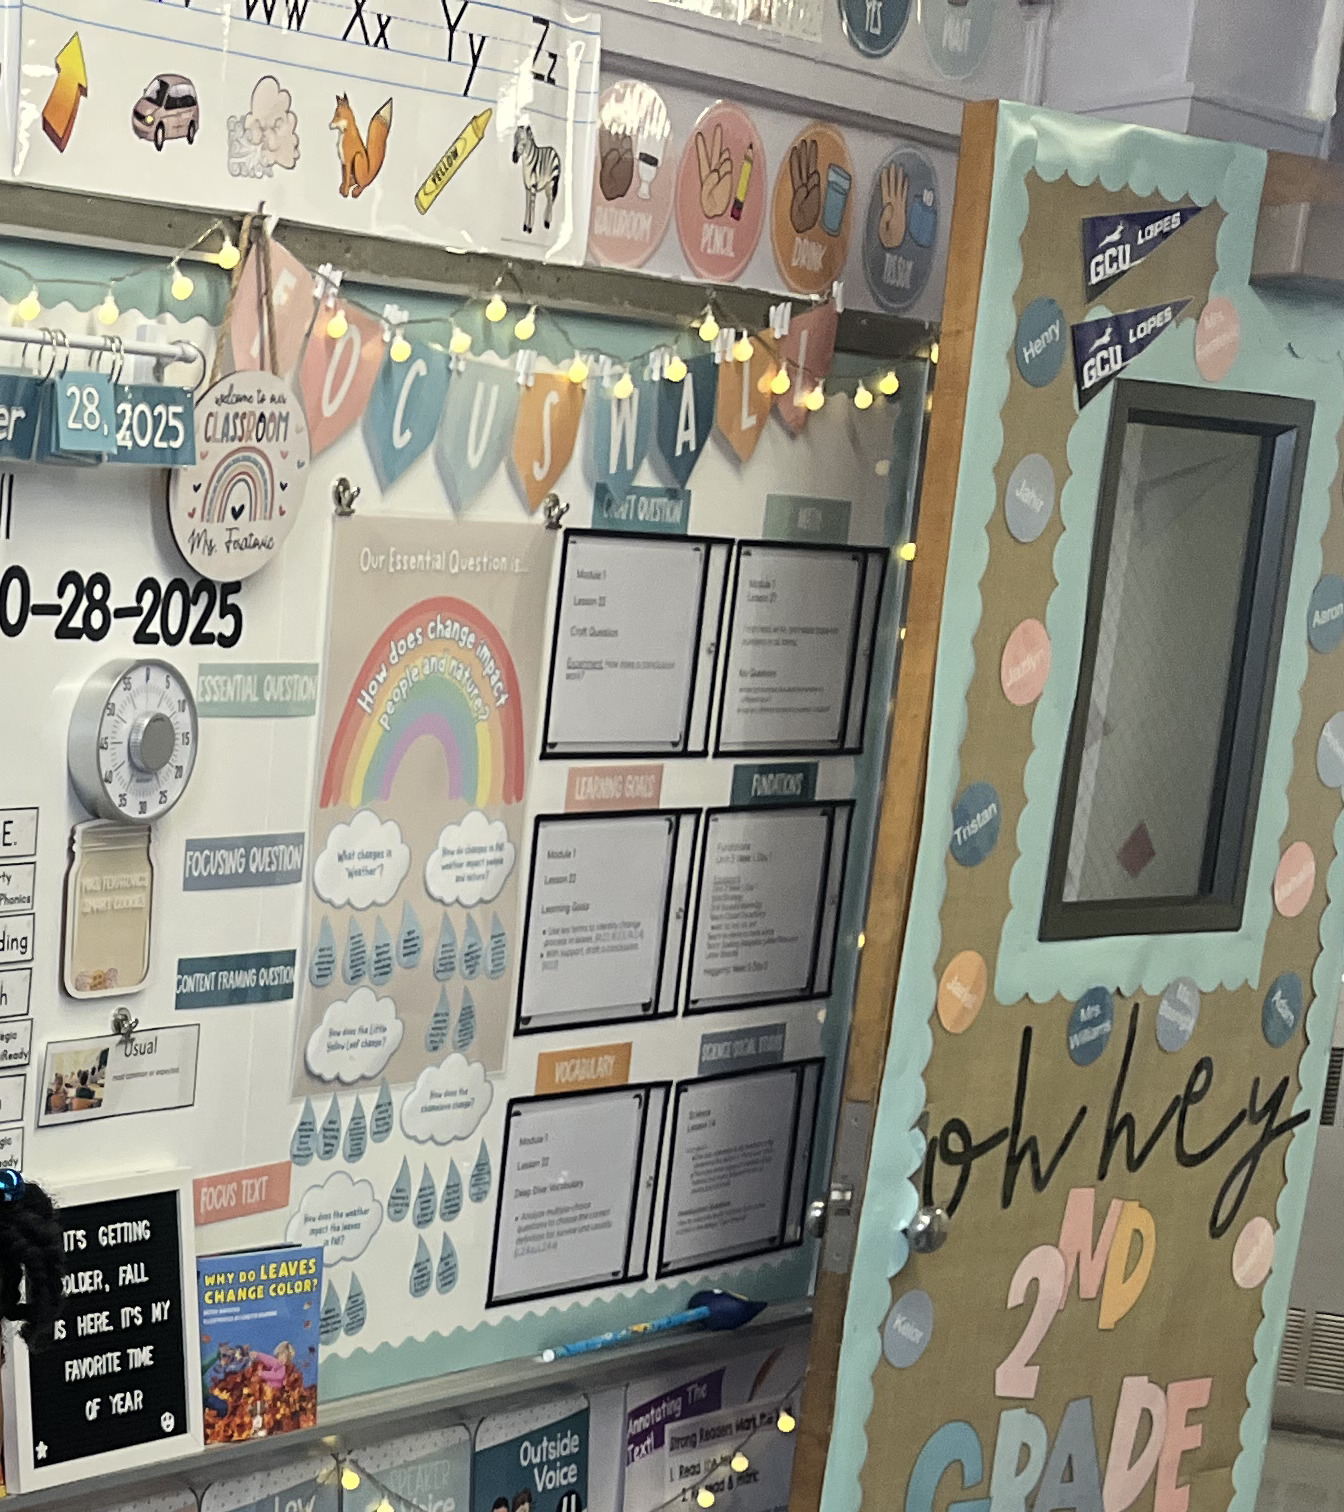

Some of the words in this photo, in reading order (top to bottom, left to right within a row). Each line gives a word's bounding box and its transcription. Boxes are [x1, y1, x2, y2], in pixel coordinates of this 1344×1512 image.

[701, 224, 735, 257] PENCIL
[1136, 212, 1181, 246] LOPES
[1088, 244, 1131, 285] GCU
[1023, 319, 1061, 364] Henry
[1128, 307, 1173, 344] LOPES
[1081, 345, 1123, 390] GCU
[66, 385, 108, 436] 28,
[115, 402, 185, 449] 2025
[204, 411, 290, 443] CLASSROOM
[357, 664, 387, 715] How
[388, 627, 423, 665] does
[427, 614, 476, 649] change
[475, 640, 509, 707] impact
[379, 665, 420, 731] people
[424, 656, 445, 674] and
[449, 656, 490, 721] nature?
[953, 802, 1000, 844] Tristan
[185, 850, 246, 878] FOCUSING
[249, 844, 302, 873] QUESTION
[176, 969, 215, 993] CONTENT
[217, 967, 256, 990] FRAMING
[259, 963, 296, 986] QUESTION
[123, 1040, 158, 1058] Usual
[554, 1055, 616, 1083] VOCABULARY
[1098, 1001, 1311, 1238] hey
[200, 1184, 235, 1214] FOCUS
[238, 1177, 267, 1209] TEXT
[63, 1229, 87, 1252] IT'S
[98, 1220, 151, 1247] GETTING
[119, 1262, 149, 1287] FALL
[205, 1273, 234, 1286] WHY
[239, 1270, 256, 1283] DO
[260, 1258, 317, 1280] LEAVES
[204, 1285, 264, 1304] CHANGE
[269, 1278, 318, 1297] COLOR?
[54, 1320, 66, 1340] IS
[77, 1311, 114, 1337] HERE.
[121, 1305, 143, 1329] IT'S
[151, 1300, 170, 1323] MY
[65, 1352, 121, 1382] FAVORITE
[127, 1345, 154, 1370] TIME
[85, 1398, 101, 1421] OF
[109, 1389, 143, 1415] YEAR
[518, 1437, 580, 1468] Outside
[533, 1463, 578, 1492] Voice
